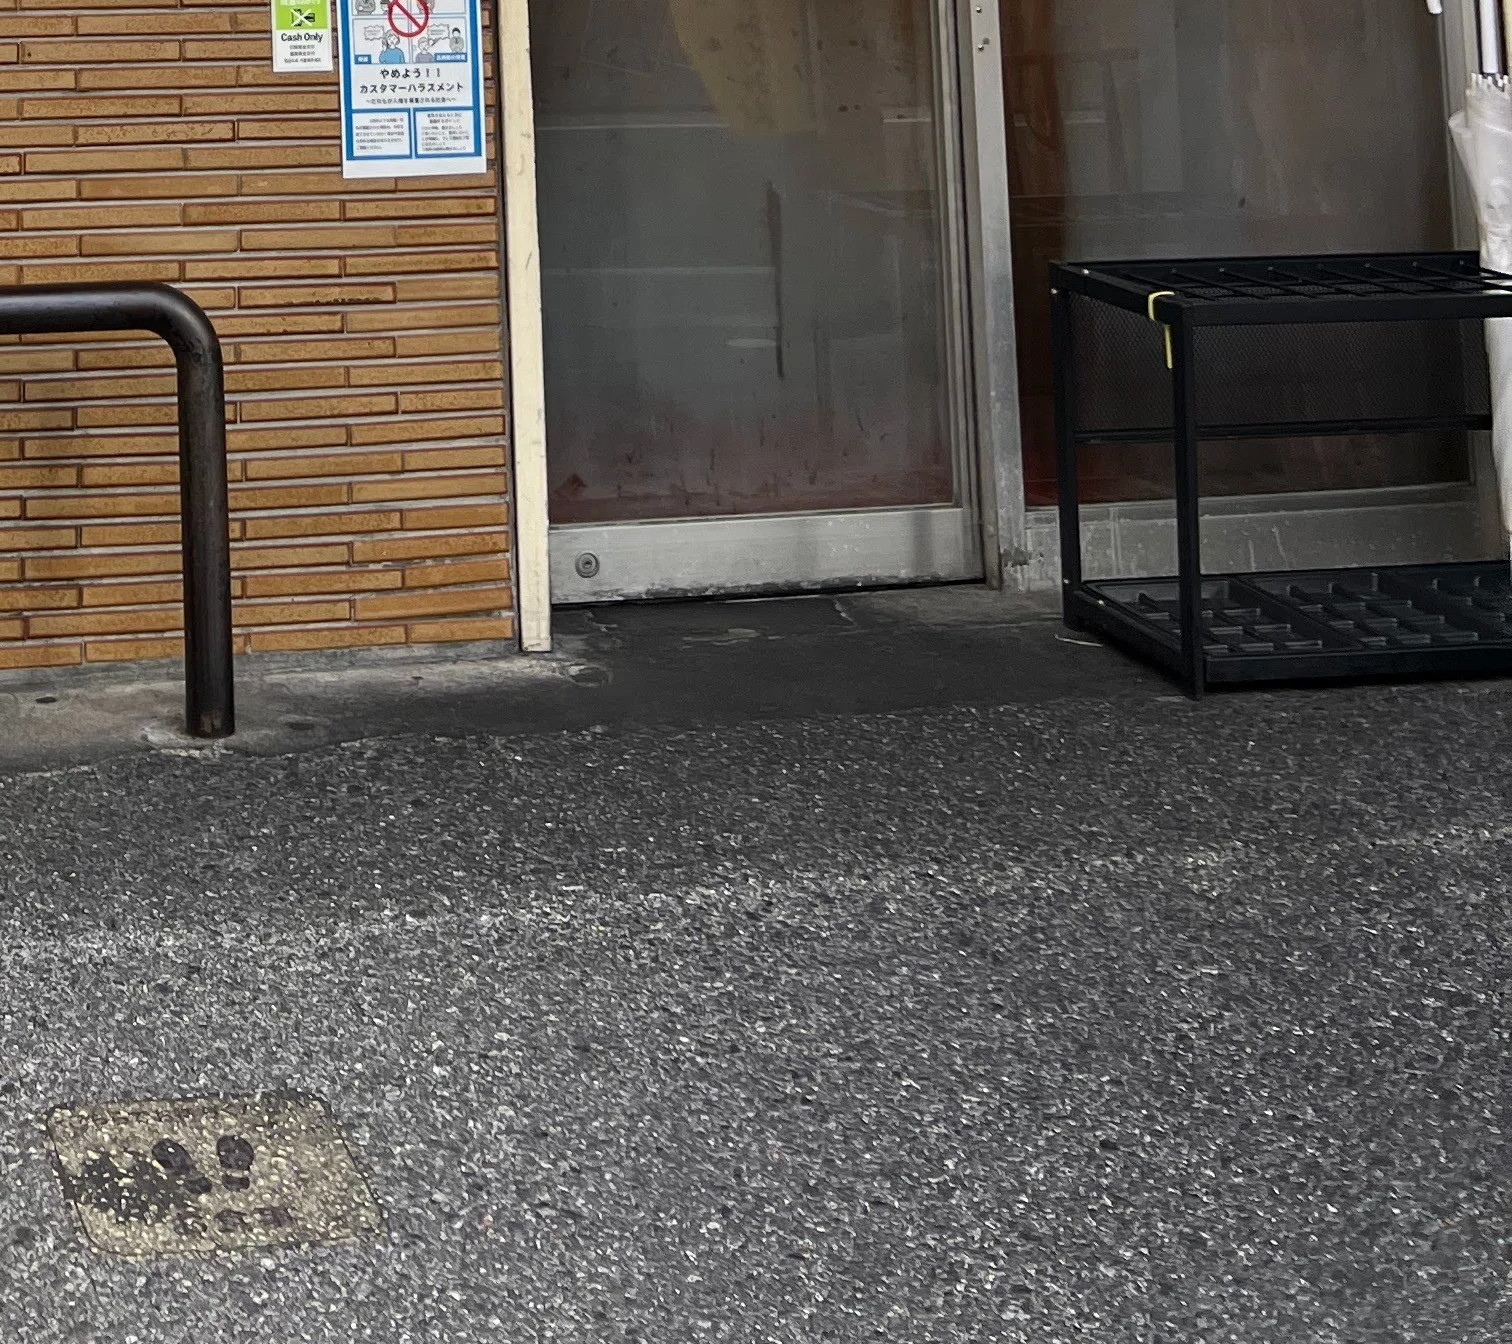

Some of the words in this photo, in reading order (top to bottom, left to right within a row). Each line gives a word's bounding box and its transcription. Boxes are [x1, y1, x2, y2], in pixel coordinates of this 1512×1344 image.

[280, 32, 303, 42] Cash
[304, 31, 324, 43] Only
[359, 81, 464, 94] カスタマーハラスメント
